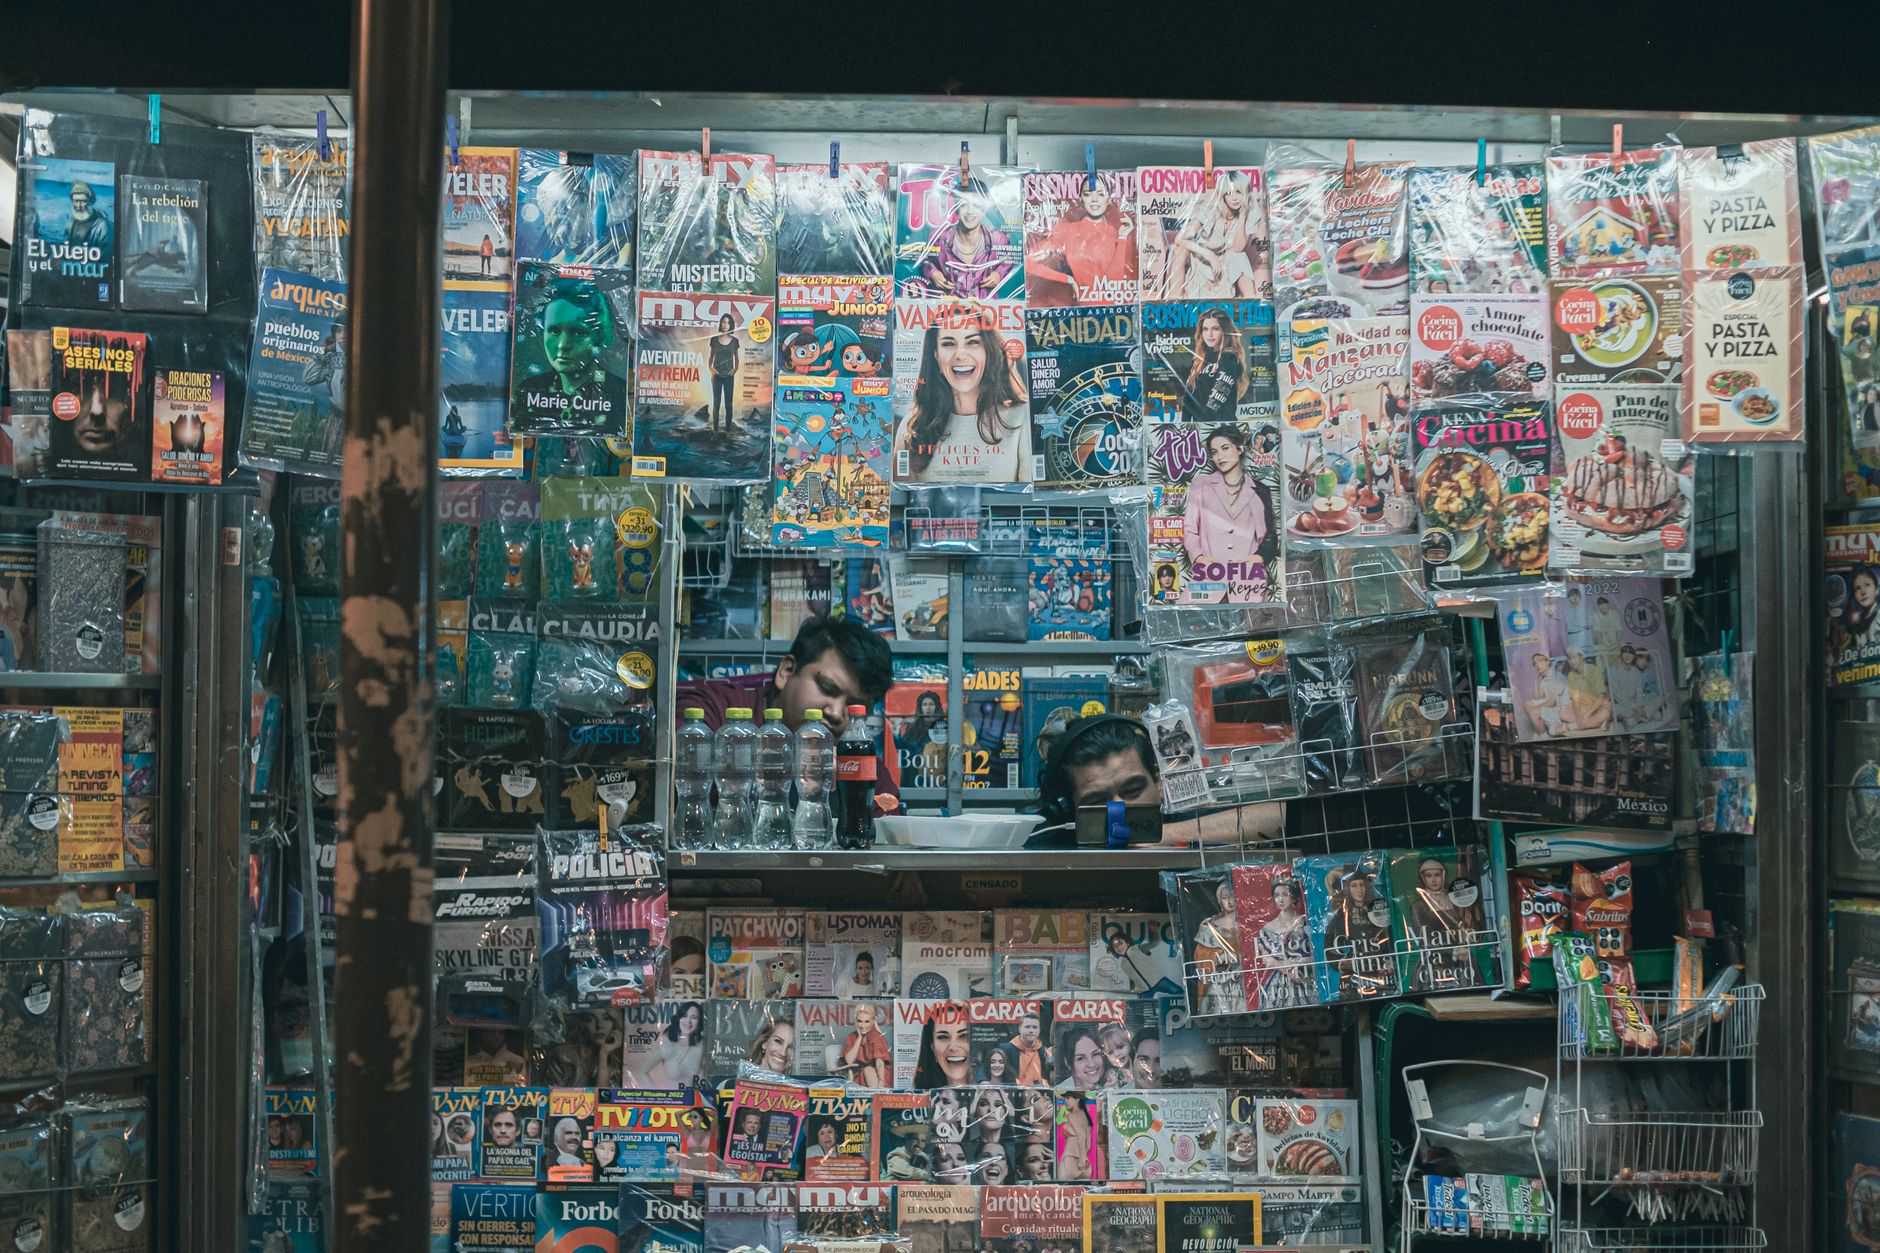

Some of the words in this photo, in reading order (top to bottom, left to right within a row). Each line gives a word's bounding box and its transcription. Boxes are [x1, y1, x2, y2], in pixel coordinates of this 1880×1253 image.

[151, 192, 199, 209] rebelión
[1150, 198, 1183, 210] Ashley
[1710, 197, 1768, 216] PASTA
[141, 212, 156, 224] del
[1141, 206, 1177, 216] Benson
[1319, 221, 1335, 231] La
[1337, 215, 1392, 230] Lechera
[1703, 217, 1717, 235] Y
[1722, 213, 1777, 232] PIZZA
[1323, 229, 1364, 241] Leche
[27, 239, 48, 258] El
[52, 239, 101, 262] viejo
[29, 260, 38, 273] y
[40, 259, 53, 272] el
[60, 261, 109, 278] mar
[670, 264, 756, 284] MISTERIOS
[780, 277, 820, 285] ESPECIAL
[820, 277, 833, 285] DE
[834, 277, 889, 286] ACTIVIDADES
[779, 285, 854, 303] muy
[827, 300, 889, 316] JUNIOR
[1559, 298, 1596, 310] Cocina
[641, 297, 771, 329] muy
[896, 303, 1025, 331] VANIDADES
[1482, 307, 1527, 322] Amor
[1560, 307, 1597, 325] Fácil
[1723, 313, 1760, 321] ESPECIAL
[753, 319, 765, 328] 10
[1421, 315, 1458, 326] Cocina
[264, 322, 320, 341] pueblos
[1422, 324, 1458, 341] Fácil
[1471, 319, 1545, 342] chocolate
[1712, 322, 1771, 339] PASTA
[262, 336, 325, 355] originarios
[1154, 333, 1191, 346] Isidora
[64, 346, 135, 362] ASESINOS
[1144, 341, 1175, 354] Vives
[1705, 342, 1718, 358] Y
[1723, 341, 1779, 357] PIZZA
[261, 348, 275, 360] de
[275, 350, 312, 365] México
[639, 350, 706, 367] AVENTURA
[65, 358, 134, 373] SERIALES
[1031, 358, 1057, 370] SALUD
[168, 370, 212, 387] ORACIONES
[258, 371, 273, 381] UNA
[638, 365, 701, 383] EXTREMA
[1031, 369, 1061, 380] DINERO
[1556, 372, 1607, 383] Cremas
[852, 383, 890, 396] JUNIOR
[1032, 379, 1056, 390] AMOR
[167, 386, 212, 402] PODEROSAS
[526, 391, 571, 412] Marie
[572, 395, 612, 413] Curie
[1288, 401, 1313, 412] Edición
[1561, 402, 1599, 414] Cocina
[1615, 395, 1646, 408] Pan
[1651, 395, 1670, 409] de
[1239, 404, 1276, 416] MGTOW
[1612, 407, 1670, 424] muerto
[1441, 410, 1486, 426] KENA
[1562, 412, 1599, 430] Fácil
[1416, 409, 1548, 449] Cocina
[917, 445, 972, 455] FELICES
[942, 455, 984, 465] KATE
[1152, 486, 1164, 508] 7
[635, 517, 646, 526] 31
[1153, 520, 1165, 529] DEL
[1166, 519, 1183, 528] CAOS
[933, 529, 949, 540] LOS
[1153, 529, 1162, 538] AL
[1162, 528, 1185, 538] ORDEN
[1191, 562, 1267, 582] SOFIA
[1227, 580, 1268, 602] Reyes
[1584, 581, 1620, 595] 2022
[773, 590, 831, 601] MURAKAMI
[543, 620, 660, 641] CLAUDIA
[567, 725, 641, 745] ORESTES
[896, 749, 939, 769] Bou
[71, 770, 121, 780] REVISTA
[68, 781, 109, 791] TUNING
[1617, 798, 1668, 812] México
[1526, 850, 1551, 859] QUAKER
[551, 848, 654, 880] POLICÍA
[965, 878, 1019, 890] CENSADO
[455, 893, 521, 907] RAPIDO
[435, 902, 510, 917] FURIOSO
[1585, 908, 1631, 924] Sabritas
[1332, 932, 1382, 956] Cris
[435, 948, 505, 968] SKYLINE
[1351, 953, 1394, 973] tina
[1419, 950, 1443, 965] Pa
[1418, 965, 1475, 983] checo
[970, 1001, 1038, 1021] CARAS
[1055, 1000, 1124, 1020] CARAS
[628, 1034, 652, 1046] Time
[636, 1027, 660, 1041] Sexy
[1231, 1056, 1244, 1071] EL
[617, 1090, 643, 1098] Especial
[643, 1090, 668, 1098] Rituales
[1114, 1104, 1148, 1117] Cocina
[859, 1123, 868, 1132] TE
[612, 1133, 642, 1143] alcanza
[644, 1133, 652, 1142] el
[653, 1133, 681, 1143] karma!
[1273, 1133, 1302, 1154] Delicias
[1301, 1131, 1315, 1139] de
[1314, 1132, 1346, 1157] Navidad
[486, 1148, 495, 1156] LA
[495, 1147, 517, 1156] AGONÍA
[518, 1148, 532, 1157] DEL
[751, 1142, 764, 1152] UN
[502, 1157, 512, 1165] DE
[900, 1187, 952, 1201] arqueología
[907, 1206, 918, 1215] EL
[918, 1206, 951, 1215] PASADO
[1189, 1206, 1230, 1215] NATIONAL
[458, 1220, 476, 1232] SIN
[476, 1220, 520, 1234] CIERRES,
[1183, 1215, 1236, 1225] GEOGRAPHIC
[1001, 1223, 1047, 1235] Comidas
[459, 1233, 479, 1245] CON
[1182, 1236, 1240, 1250] REVOLUCIÓN
